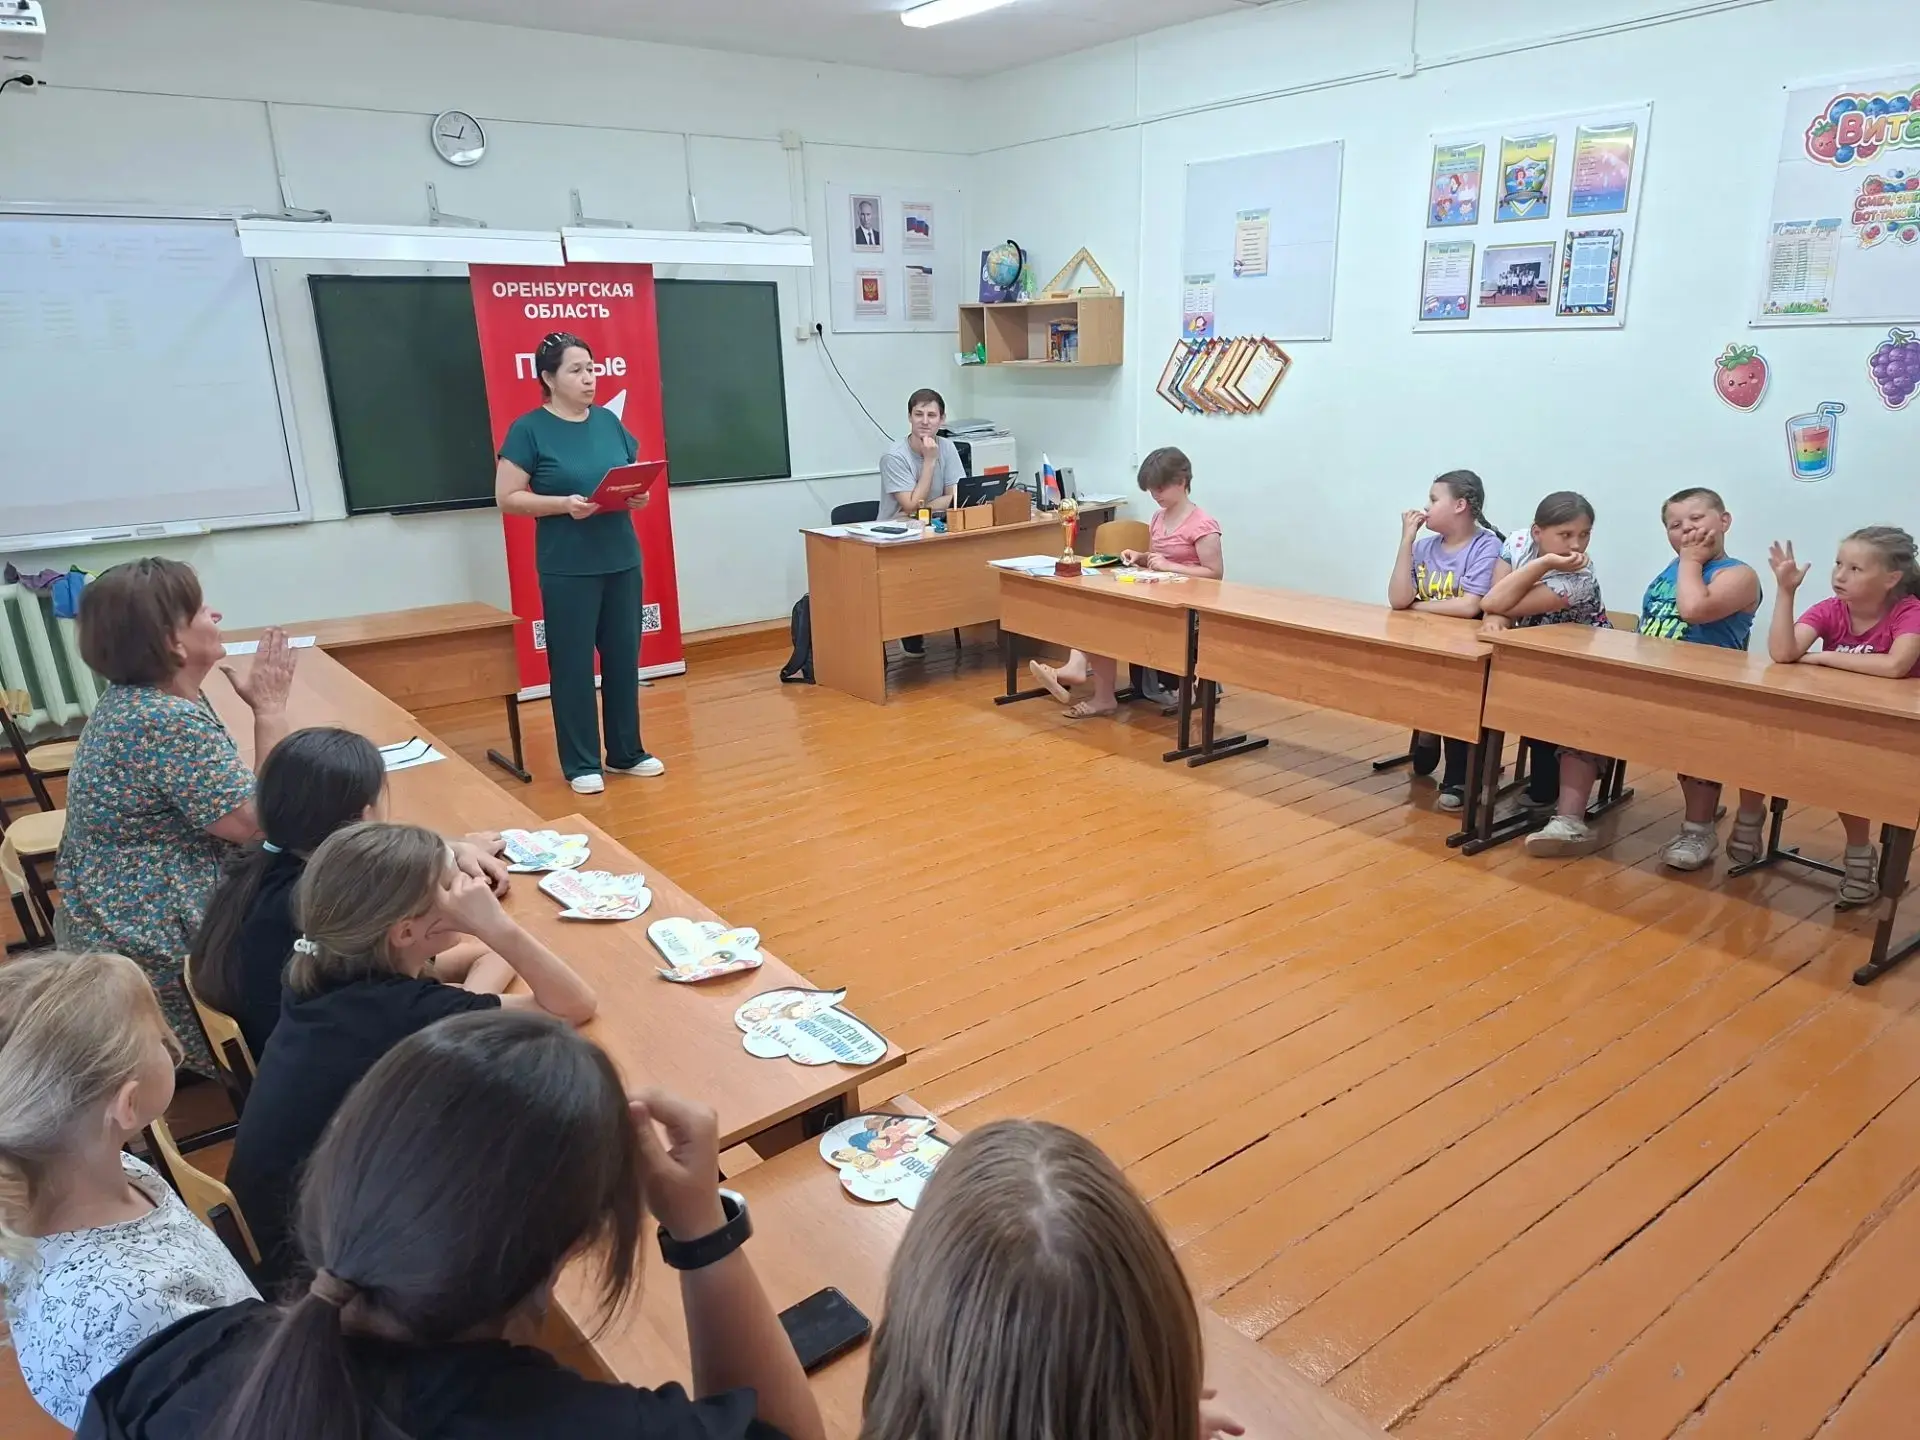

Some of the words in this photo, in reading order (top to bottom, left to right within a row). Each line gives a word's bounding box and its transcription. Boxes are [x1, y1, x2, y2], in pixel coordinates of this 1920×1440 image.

[491, 281, 634, 298] ОРЕНБУРГСКАЯ
[524, 303, 610, 319] ОБЛАСТЬ
[515, 352, 627, 380] Пые
[794, 1019, 827, 1038] ПРАВО
[819, 1030, 852, 1057] ИМЕЮ
[859, 1038, 877, 1055] НА
